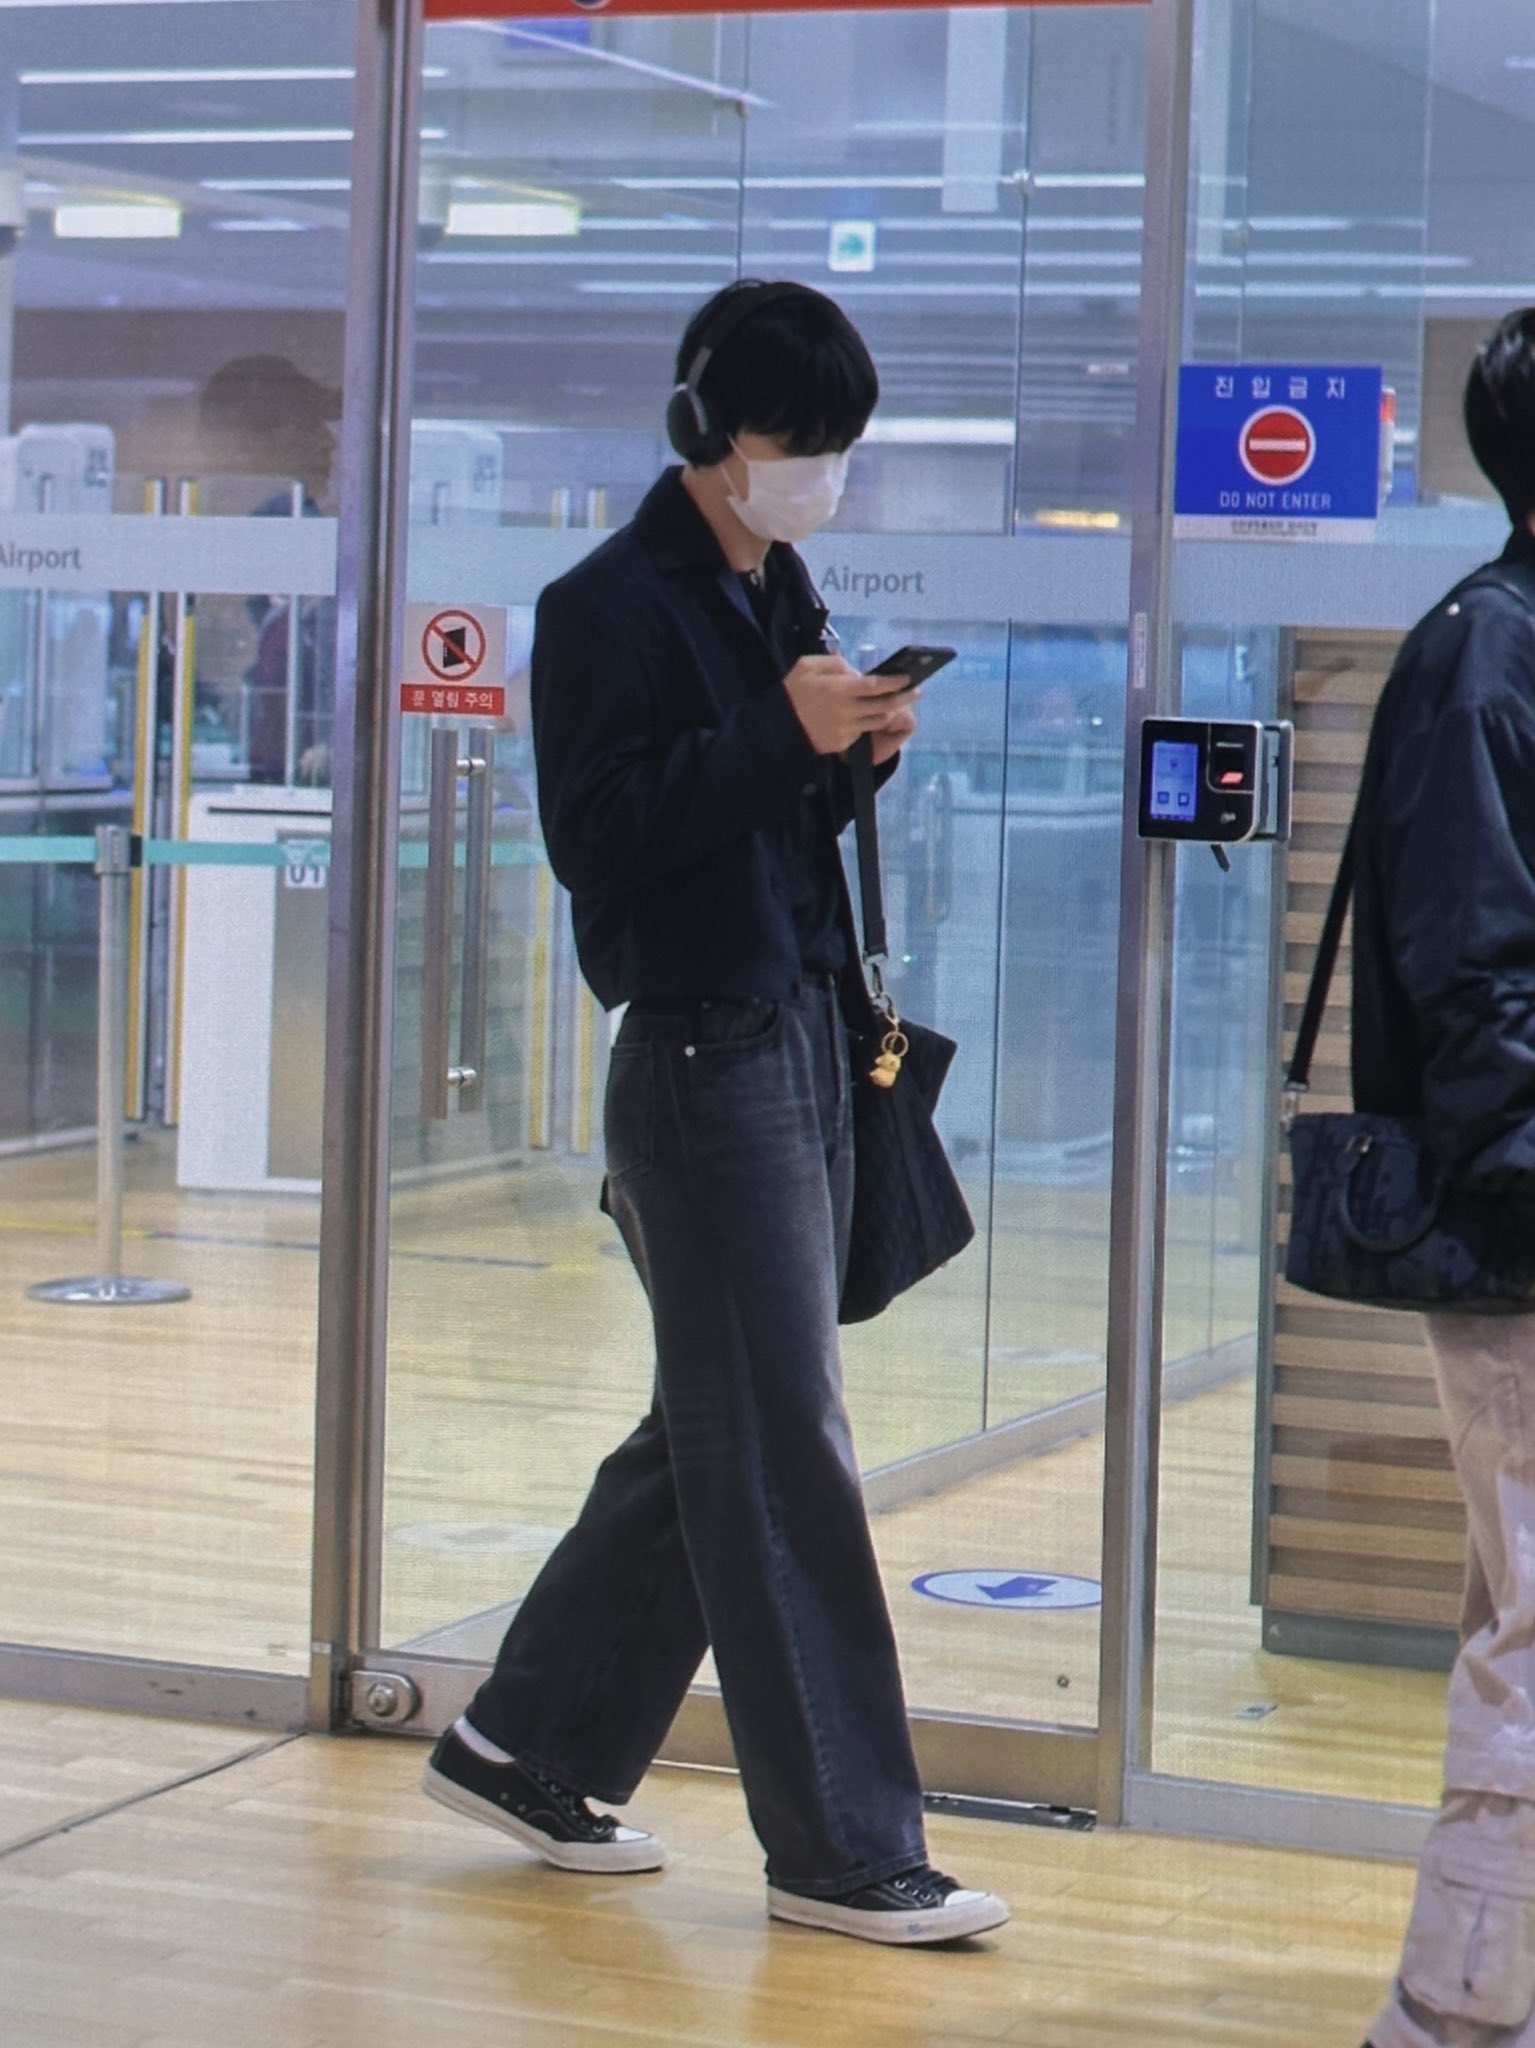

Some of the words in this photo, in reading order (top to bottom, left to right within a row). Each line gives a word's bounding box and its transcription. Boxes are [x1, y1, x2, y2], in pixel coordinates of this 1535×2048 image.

[1219, 491, 1240, 508] DO
[1246, 492, 1275, 508] NOT
[1282, 492, 1332, 510] ENTER
[820, 565, 925, 598] Airport
[465, 691, 493, 709] 주의
